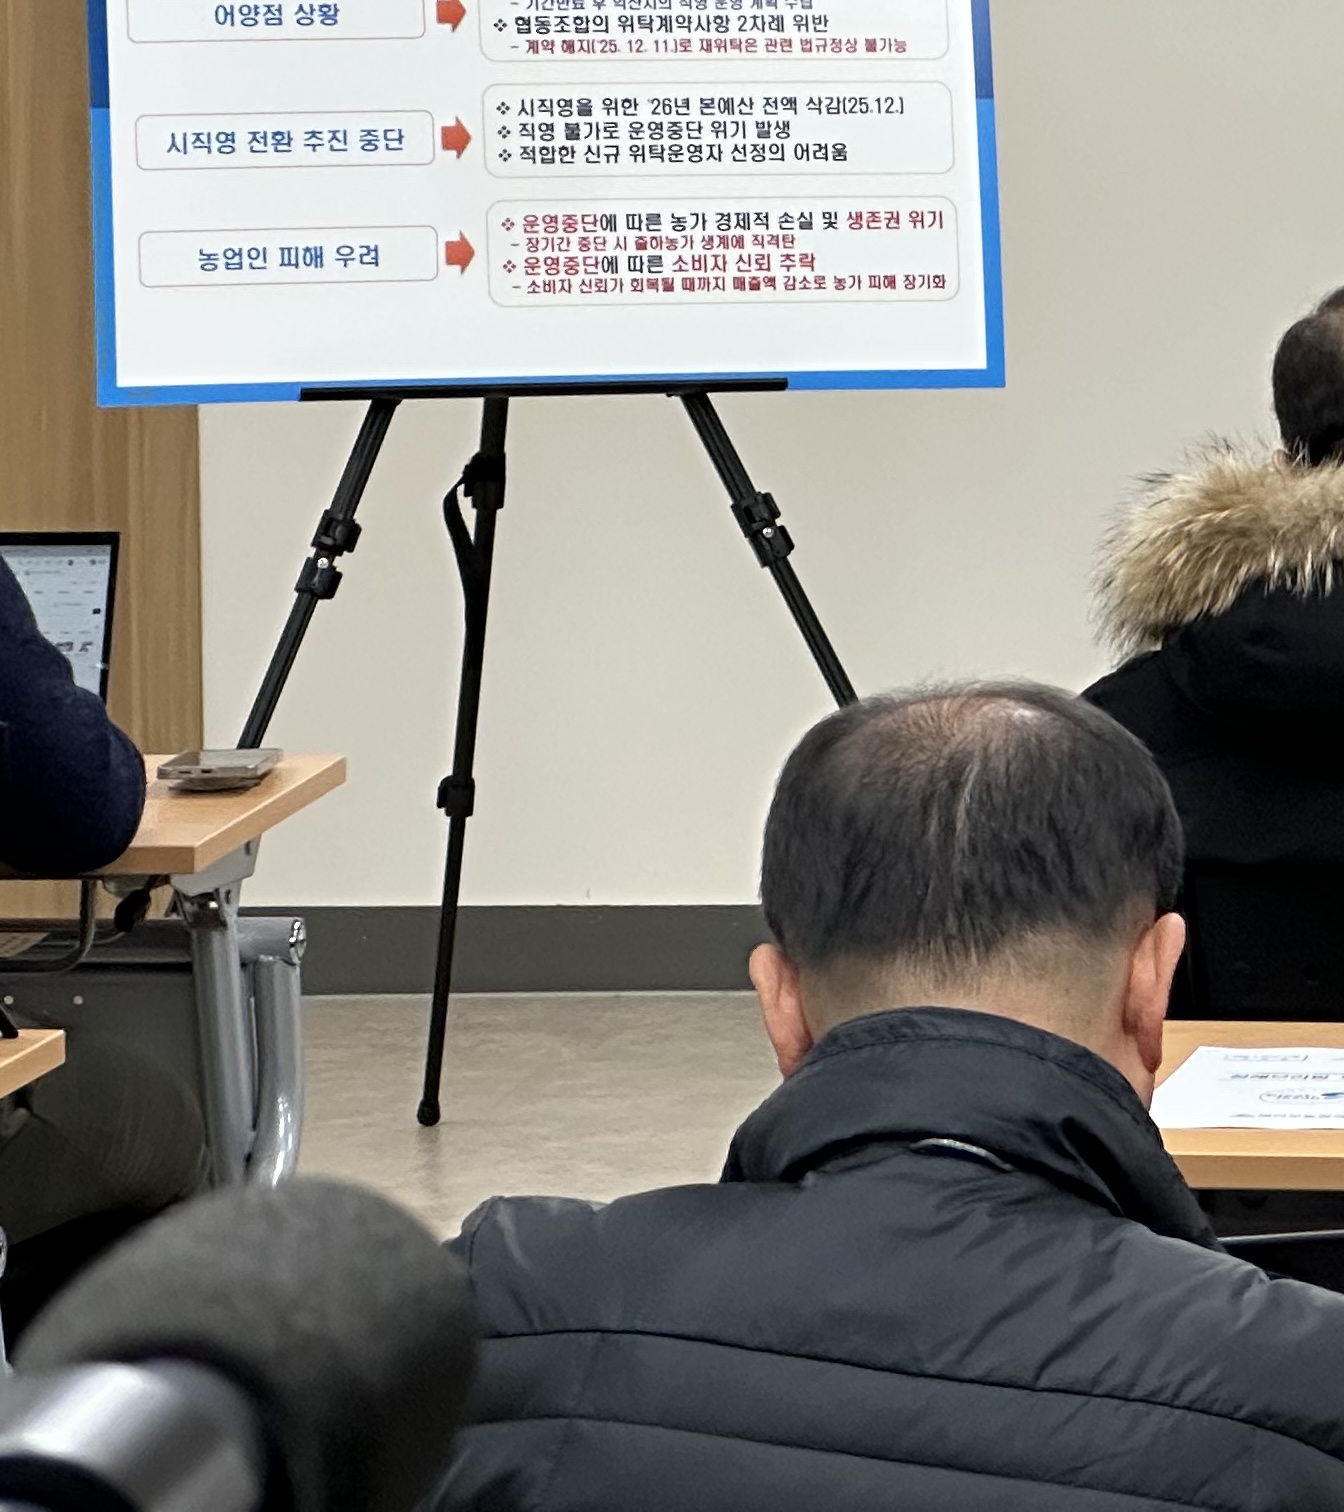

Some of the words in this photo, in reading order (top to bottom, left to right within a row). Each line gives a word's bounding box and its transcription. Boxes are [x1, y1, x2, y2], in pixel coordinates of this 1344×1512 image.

[214, 4, 283, 27] 어양점
[294, 3, 340, 27] 상황
[514, 15, 609, 35] 협동조합의
[617, 14, 731, 34] 위탁계약사항
[737, 14, 785, 33] 2차례
[792, 14, 829, 33] 위반
[517, 97, 593, 118] 시직영을
[602, 97, 639, 117] 위한
[699, 97, 755, 116] 본예산
[762, 96, 798, 116] 전액
[166, 131, 236, 155] 시직영
[247, 130, 294, 154] 전환
[303, 129, 348, 152] 추진
[359, 128, 405, 152] 중단
[519, 122, 555, 142] 직영
[564, 121, 620, 141] 불가로
[628, 121, 704, 141] 운영중단
[710, 120, 747, 140] 위기
[755, 120, 791, 140] 발생
[519, 145, 576, 165] 적합한
[583, 144, 620, 164] 신규
[629, 143, 723, 163] 위탁운영자
[730, 143, 785, 163] 선정의
[793, 142, 848, 162] 어려움
[522, 213, 617, 234] 운영중단에
[625, 213, 662, 232] 따른
[670, 212, 708, 234] 농가
[715, 211, 770, 234] 경제적
[778, 211, 814, 233] 손실
[822, 211, 838, 230] 및
[846, 211, 900, 231] 생존권
[908, 210, 944, 229] 위기
[198, 247, 267, 272] 농업인
[278, 246, 324, 269] 피해
[335, 245, 379, 268] 우려
[523, 255, 619, 276] 운영중단에
[627, 254, 664, 274] 따른
[672, 254, 728, 273] 소비자
[735, 253, 771, 273] 신뢰
[780, 252, 816, 272] 추락
